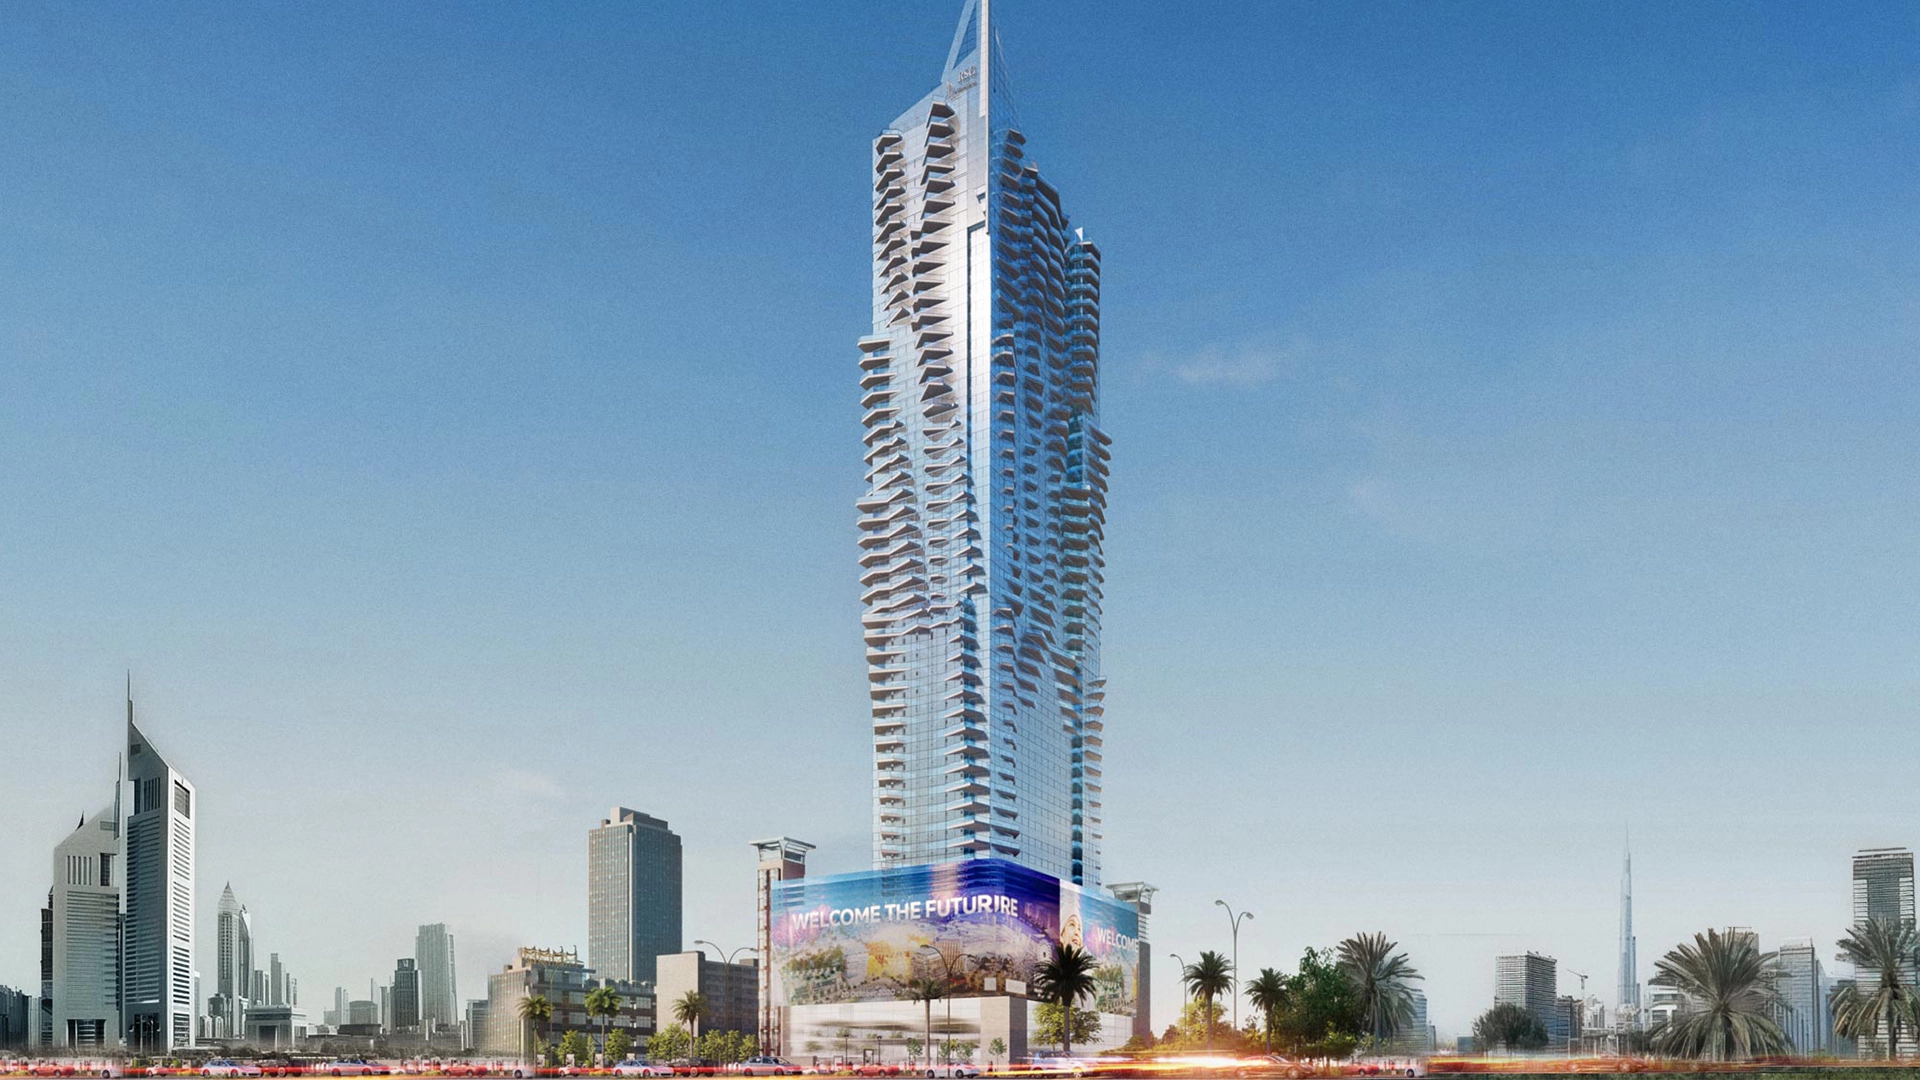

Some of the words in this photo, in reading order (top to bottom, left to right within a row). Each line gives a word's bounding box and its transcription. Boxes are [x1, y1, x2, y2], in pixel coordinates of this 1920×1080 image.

[791, 905, 881, 930] WELCOME
[884, 901, 921, 921] THE
[1097, 927, 1139, 953] WELCOME
